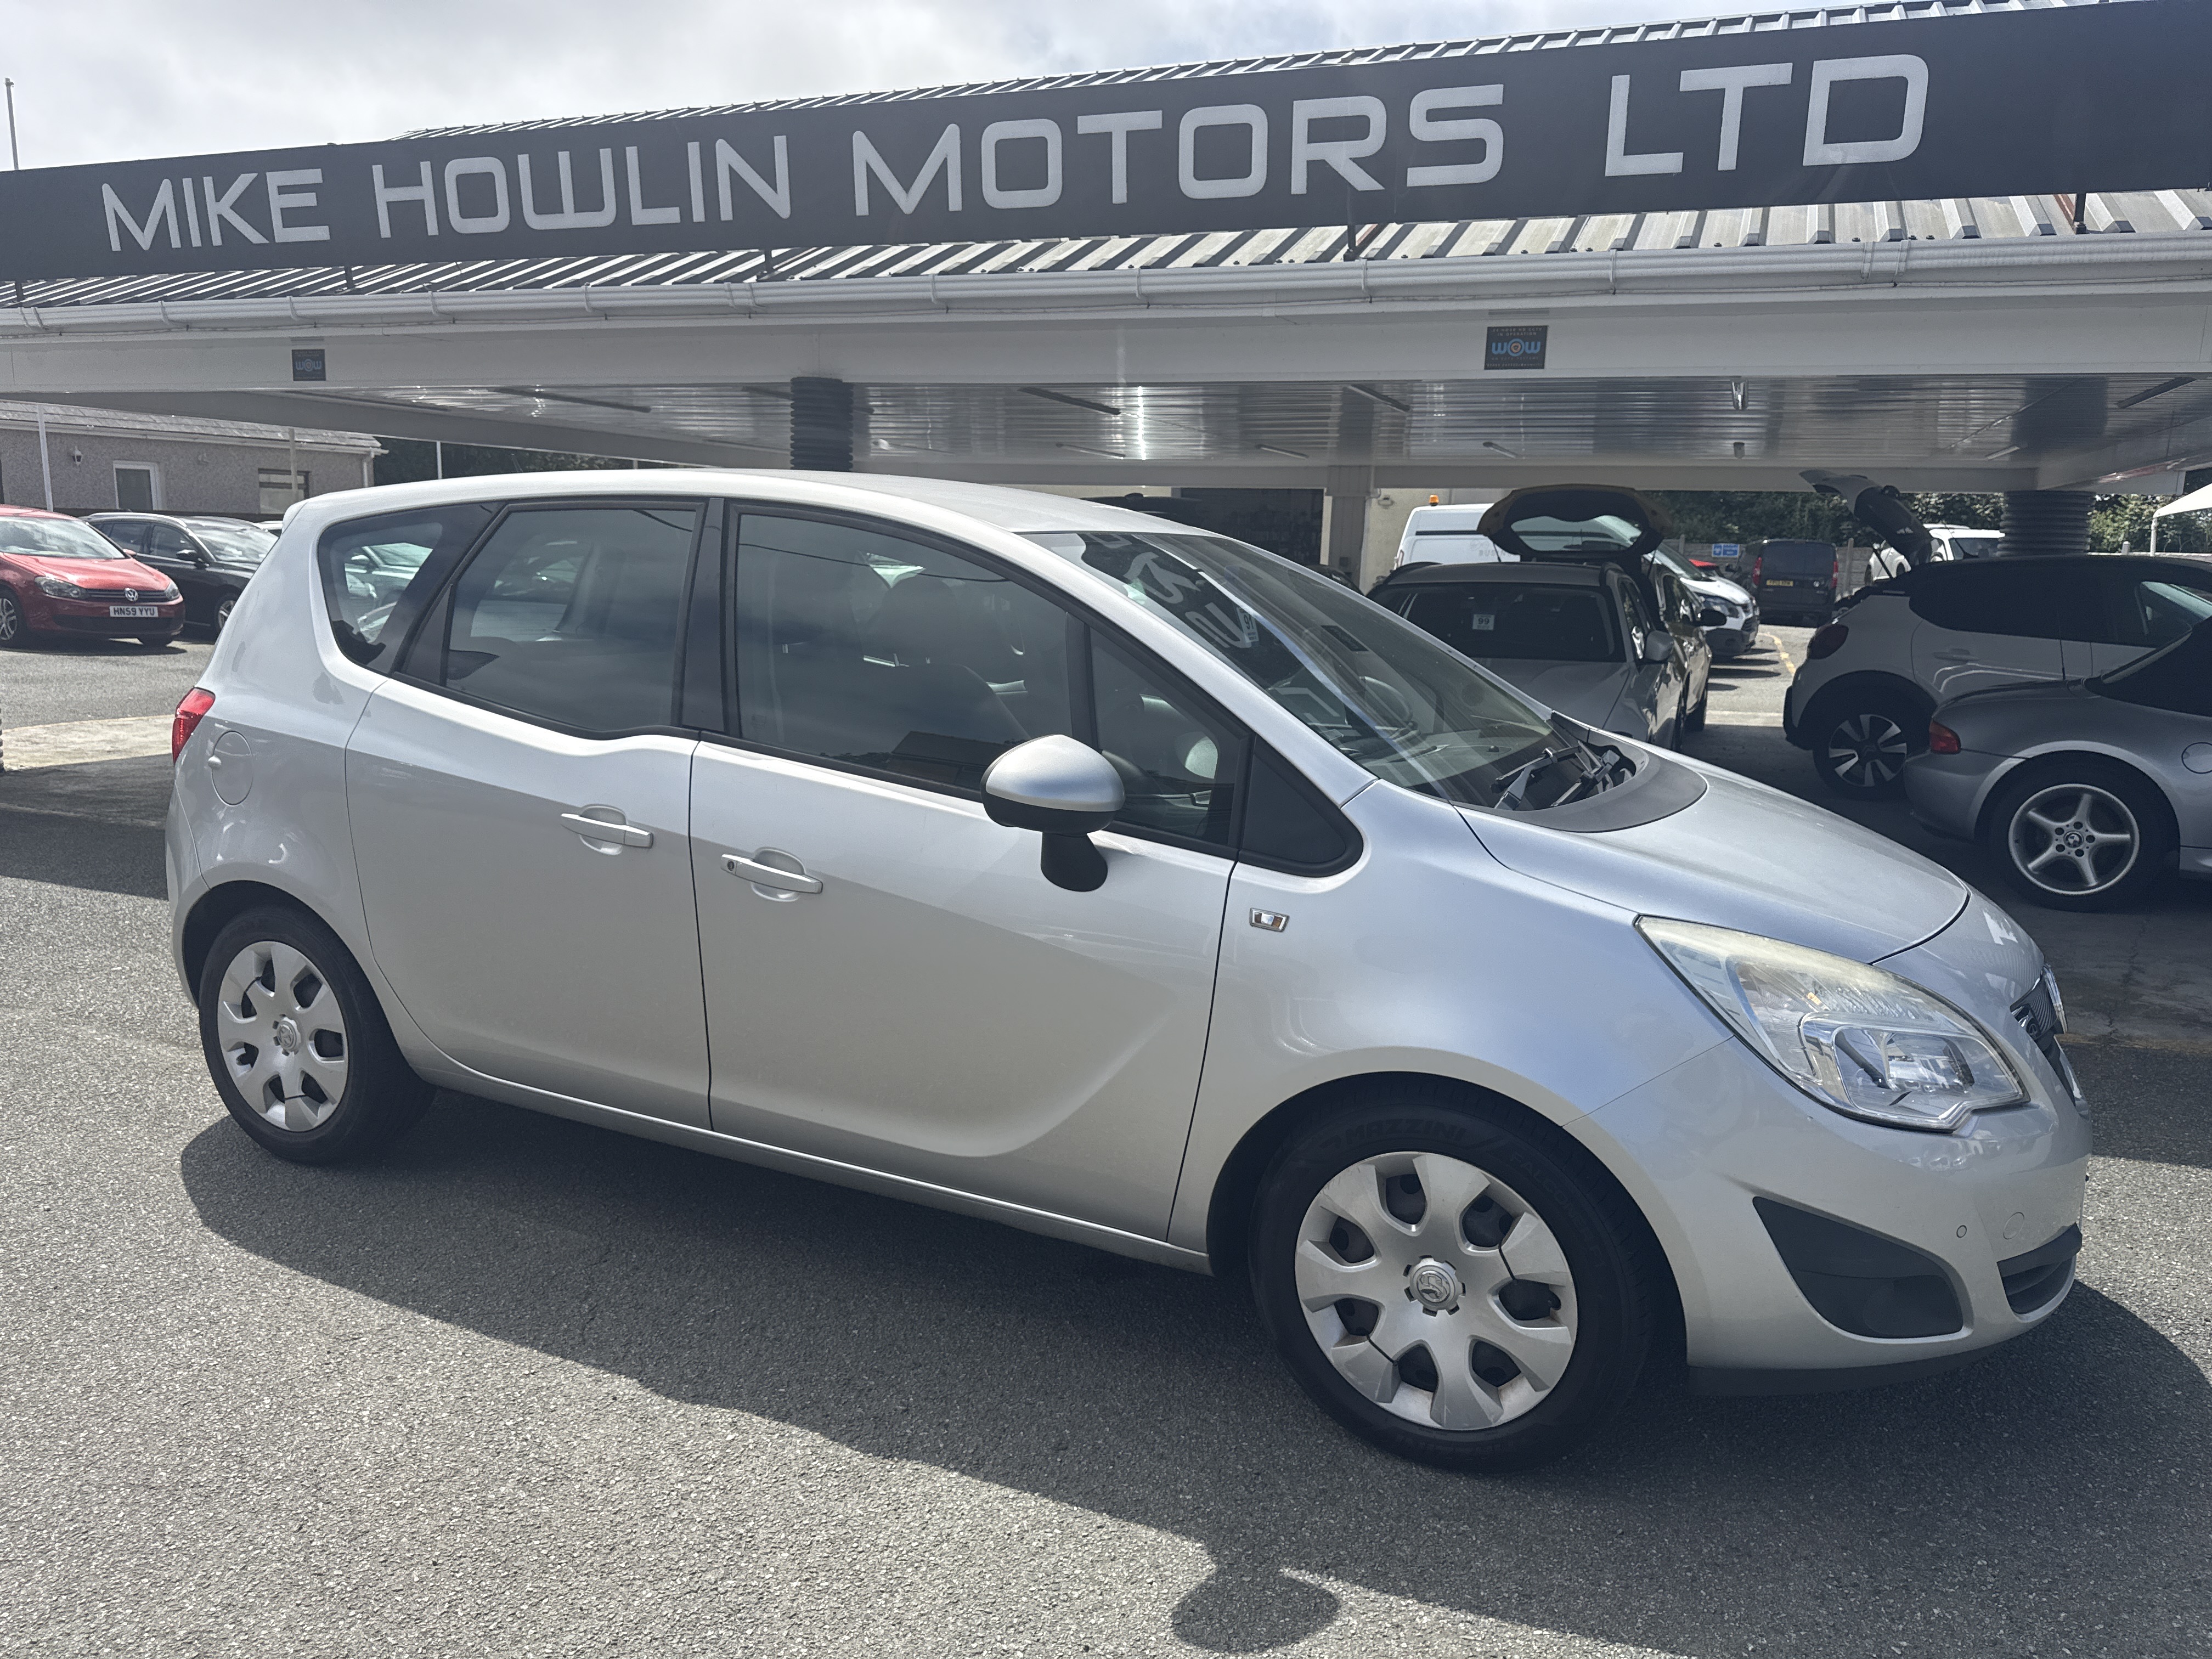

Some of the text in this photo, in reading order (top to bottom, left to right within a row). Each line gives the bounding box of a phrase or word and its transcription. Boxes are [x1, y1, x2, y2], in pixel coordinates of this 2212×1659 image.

[101, 54, 1929, 252] MIKE HOWLIN MOTORS LTD
[113, 607, 155, 616] HN59 YYU
[1244, 614, 1254, 630] 91
[1344, 1117, 1468, 1146] MAZZINI
